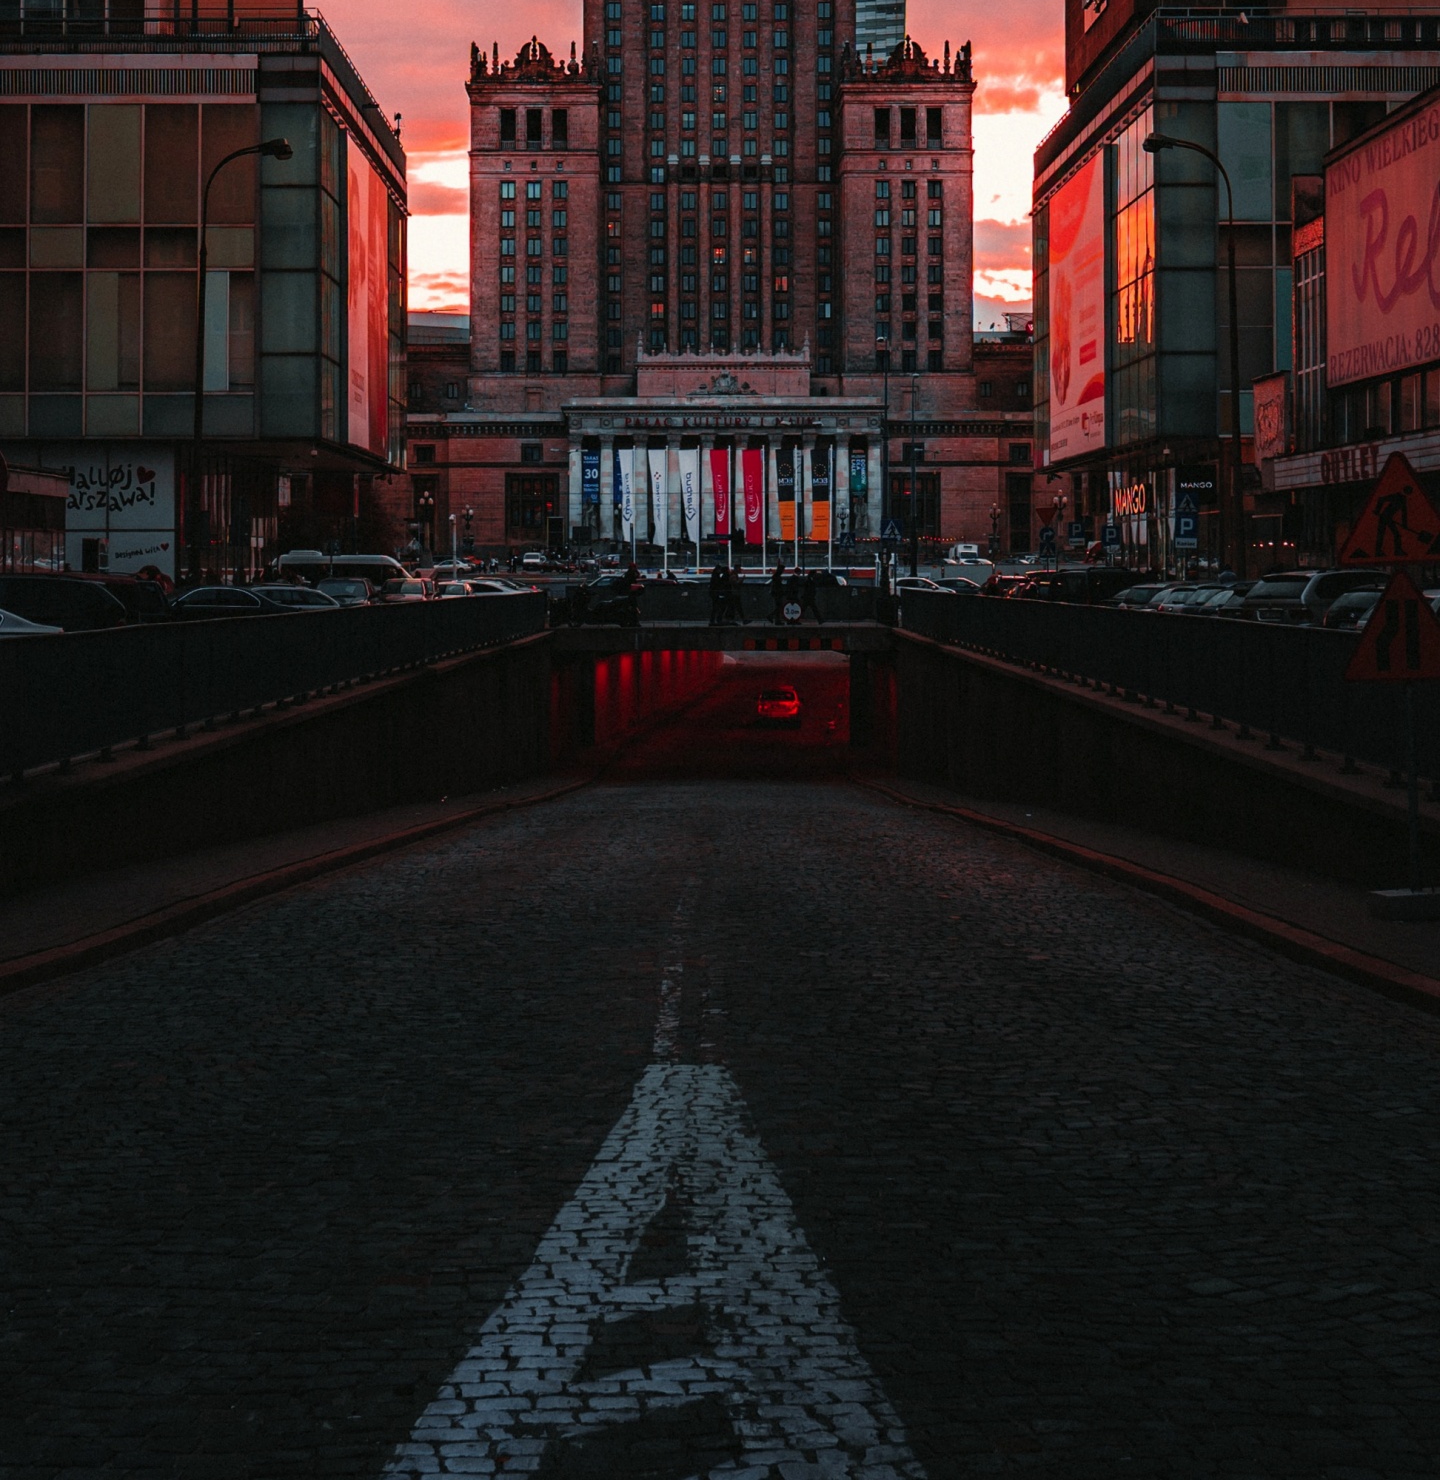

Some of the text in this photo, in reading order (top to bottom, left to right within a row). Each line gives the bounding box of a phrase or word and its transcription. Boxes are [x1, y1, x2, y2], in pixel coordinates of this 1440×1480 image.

[1329, 155, 1361, 197] KINO
[1329, 323, 1440, 385] REZERWACJA: 828
[683, 417, 751, 426] KULTURY
[584, 468, 599, 479] 30
[1181, 481, 1213, 489] MANGO
[67, 482, 155, 512] arszawa!
[1114, 483, 1147, 517] MANGO
[1072, 523, 1082, 537] P
[1105, 527, 1117, 542] P
[1180, 518, 1193, 535] P
